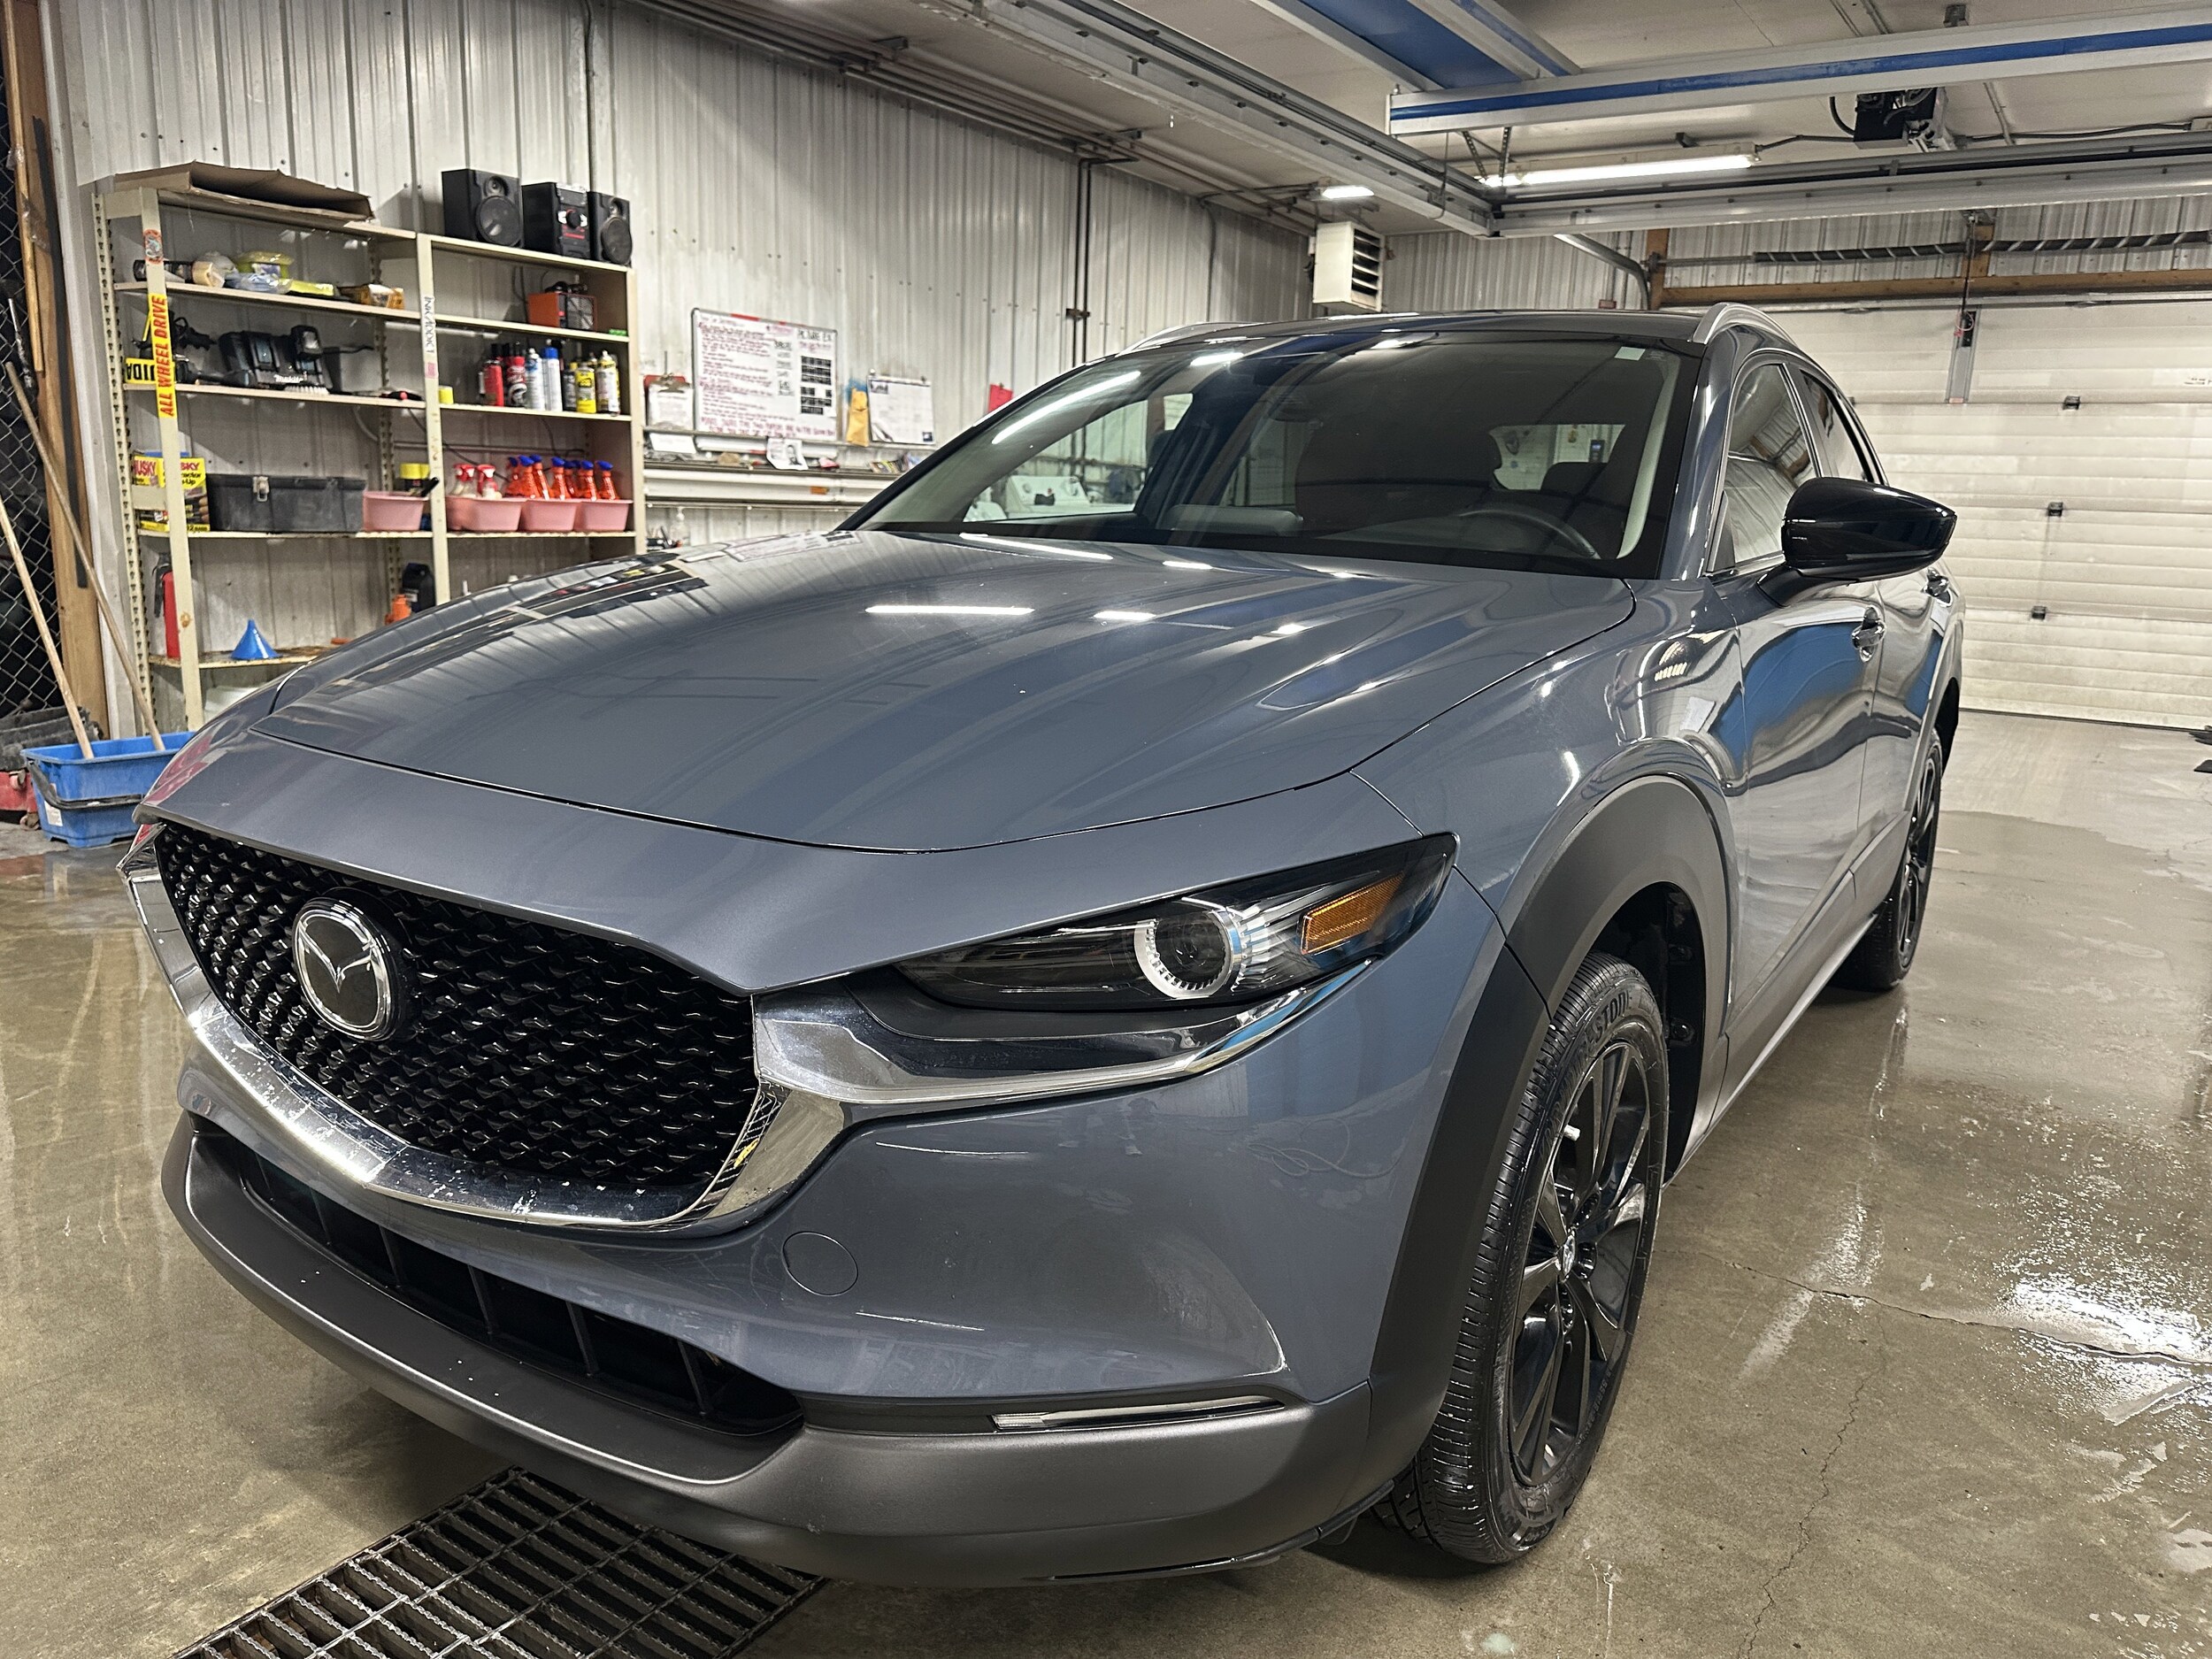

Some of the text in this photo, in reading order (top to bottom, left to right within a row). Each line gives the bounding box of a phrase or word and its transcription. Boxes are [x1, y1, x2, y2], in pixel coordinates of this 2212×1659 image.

[151, 295, 175, 418] ALL WHEEL DRIVE
